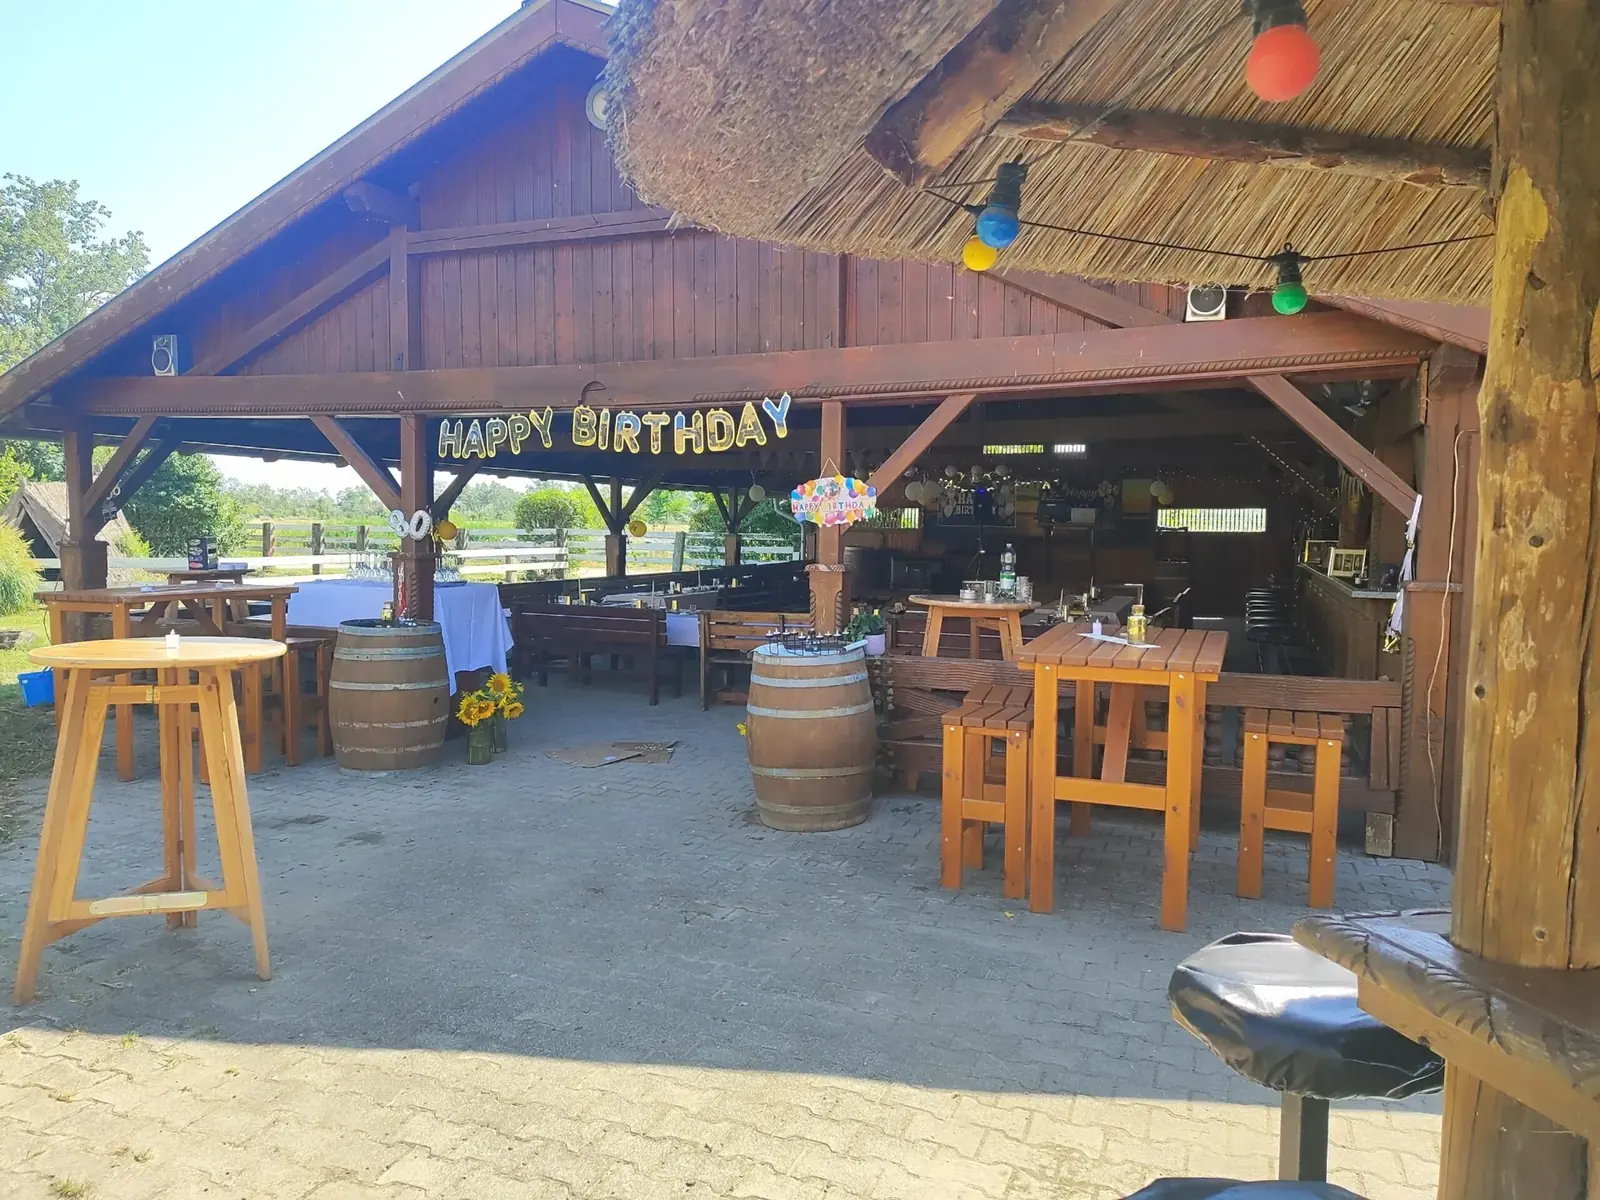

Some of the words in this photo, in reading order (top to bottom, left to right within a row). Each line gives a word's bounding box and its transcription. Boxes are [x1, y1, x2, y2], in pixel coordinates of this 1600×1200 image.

[438, 406, 553, 459] HAPPY
[572, 392, 791, 454] BIRTHDAY
[792, 502, 818, 512] HAPPY
[388, 509, 431, 540] 80
